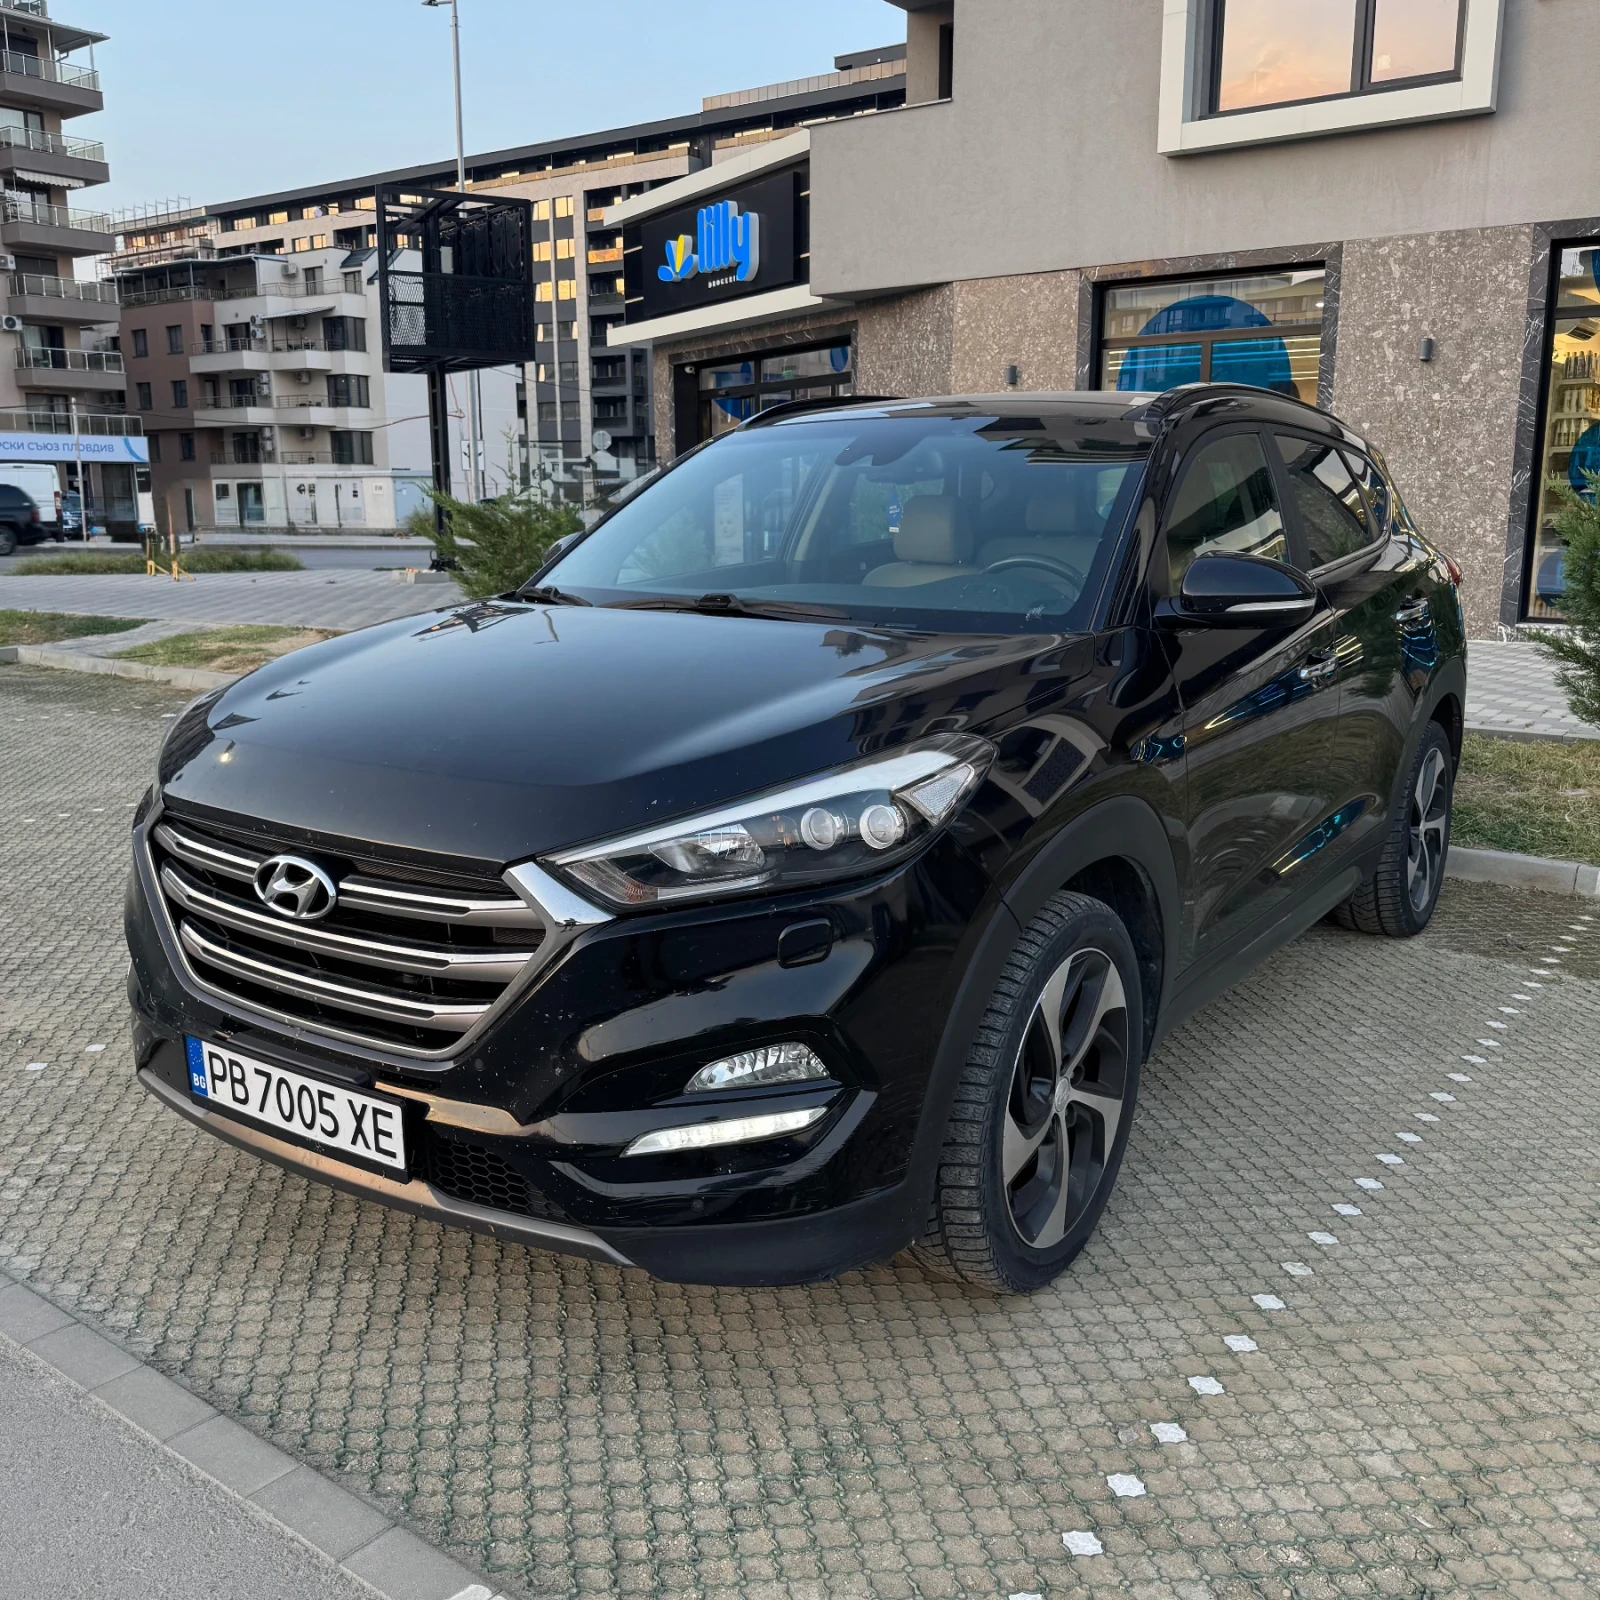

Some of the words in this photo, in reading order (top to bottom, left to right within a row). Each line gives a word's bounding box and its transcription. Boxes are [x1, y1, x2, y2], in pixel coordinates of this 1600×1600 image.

[697, 200, 759, 281] lilly
[708, 275, 738, 288] DROGERI
[27, 441, 60, 451] СЪЮЗ
[193, 1072, 206, 1089] BG
[208, 1050, 249, 1105] PB
[253, 1067, 339, 1138] 7005
[347, 1098, 397, 1159] XE
